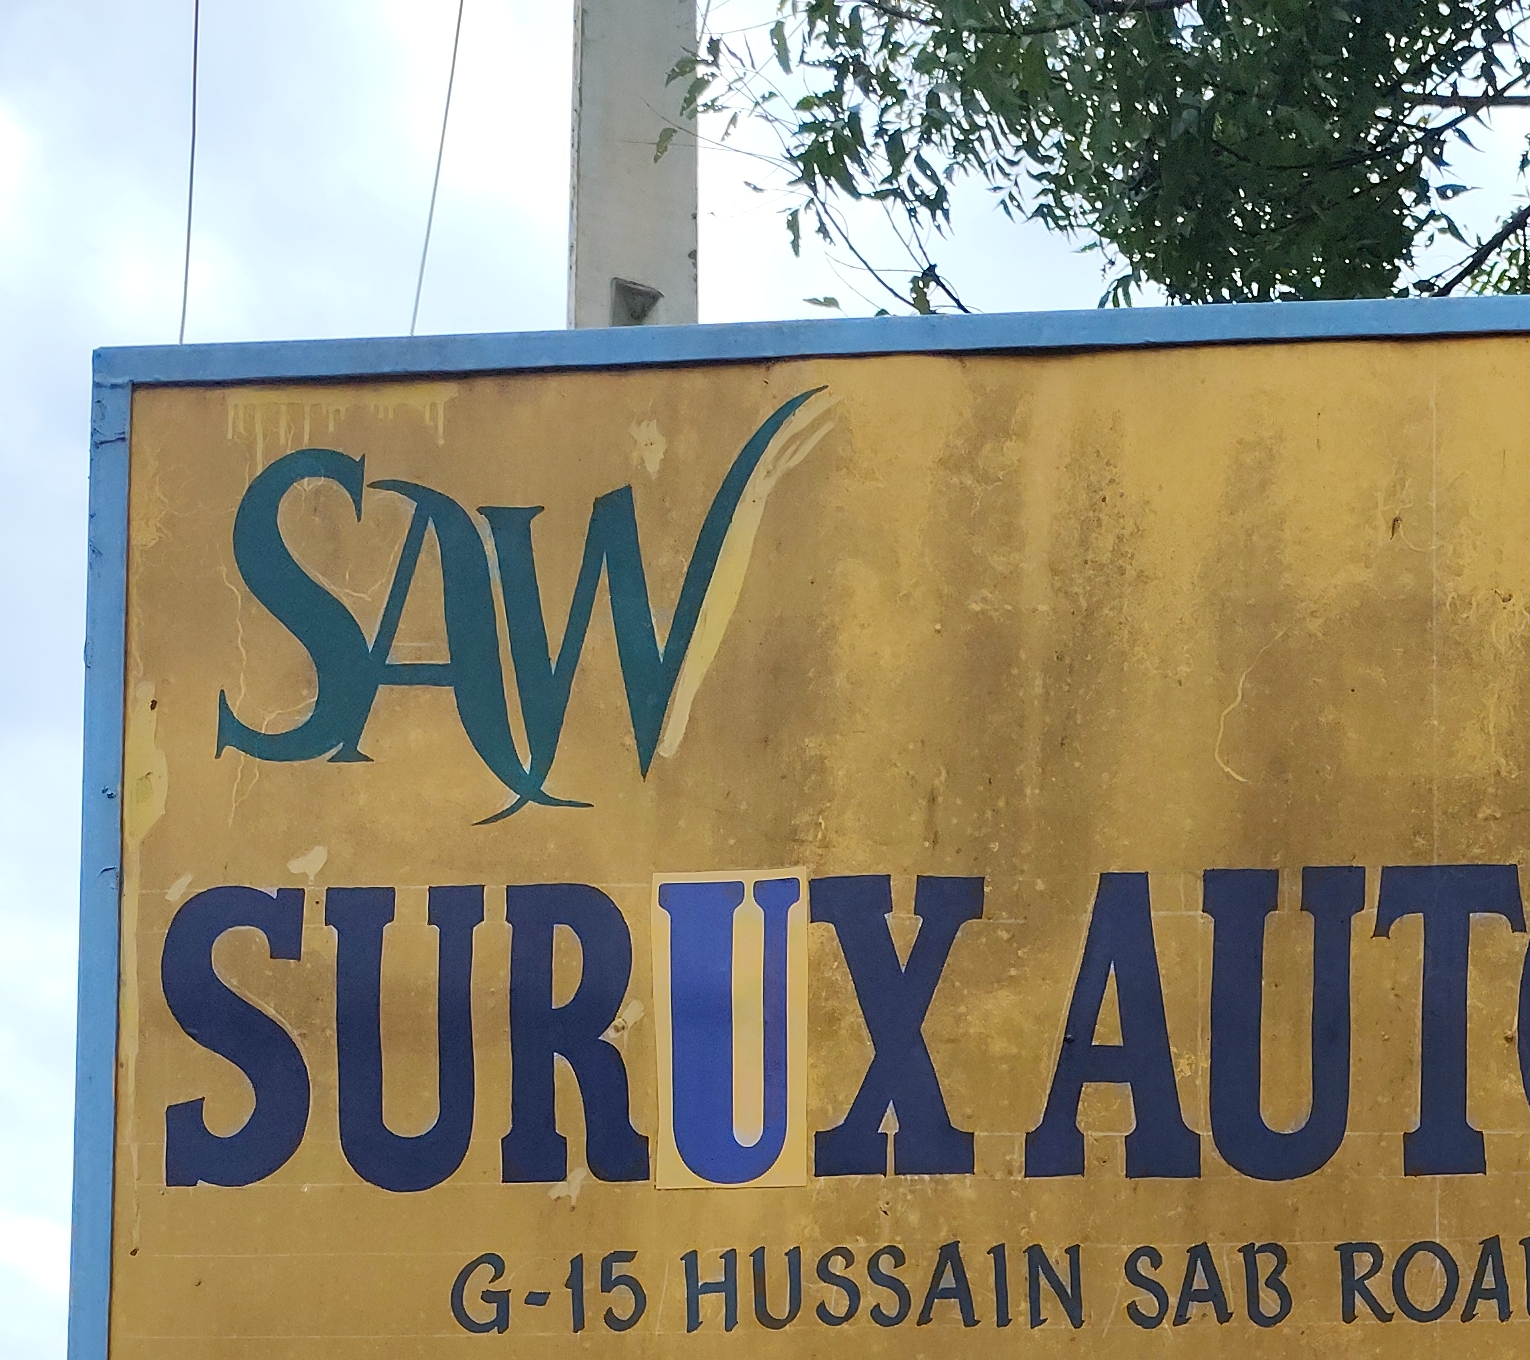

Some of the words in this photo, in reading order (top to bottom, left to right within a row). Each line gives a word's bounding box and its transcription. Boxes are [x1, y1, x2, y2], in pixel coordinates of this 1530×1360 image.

[214, 385, 827, 826] SAW
[161, 876, 984, 1192] SURUX
[450, 1250, 647, 1334] G-15
[680, 1240, 1085, 1333] HUSSAIN
[1126, 1242, 1292, 1329] SAB
